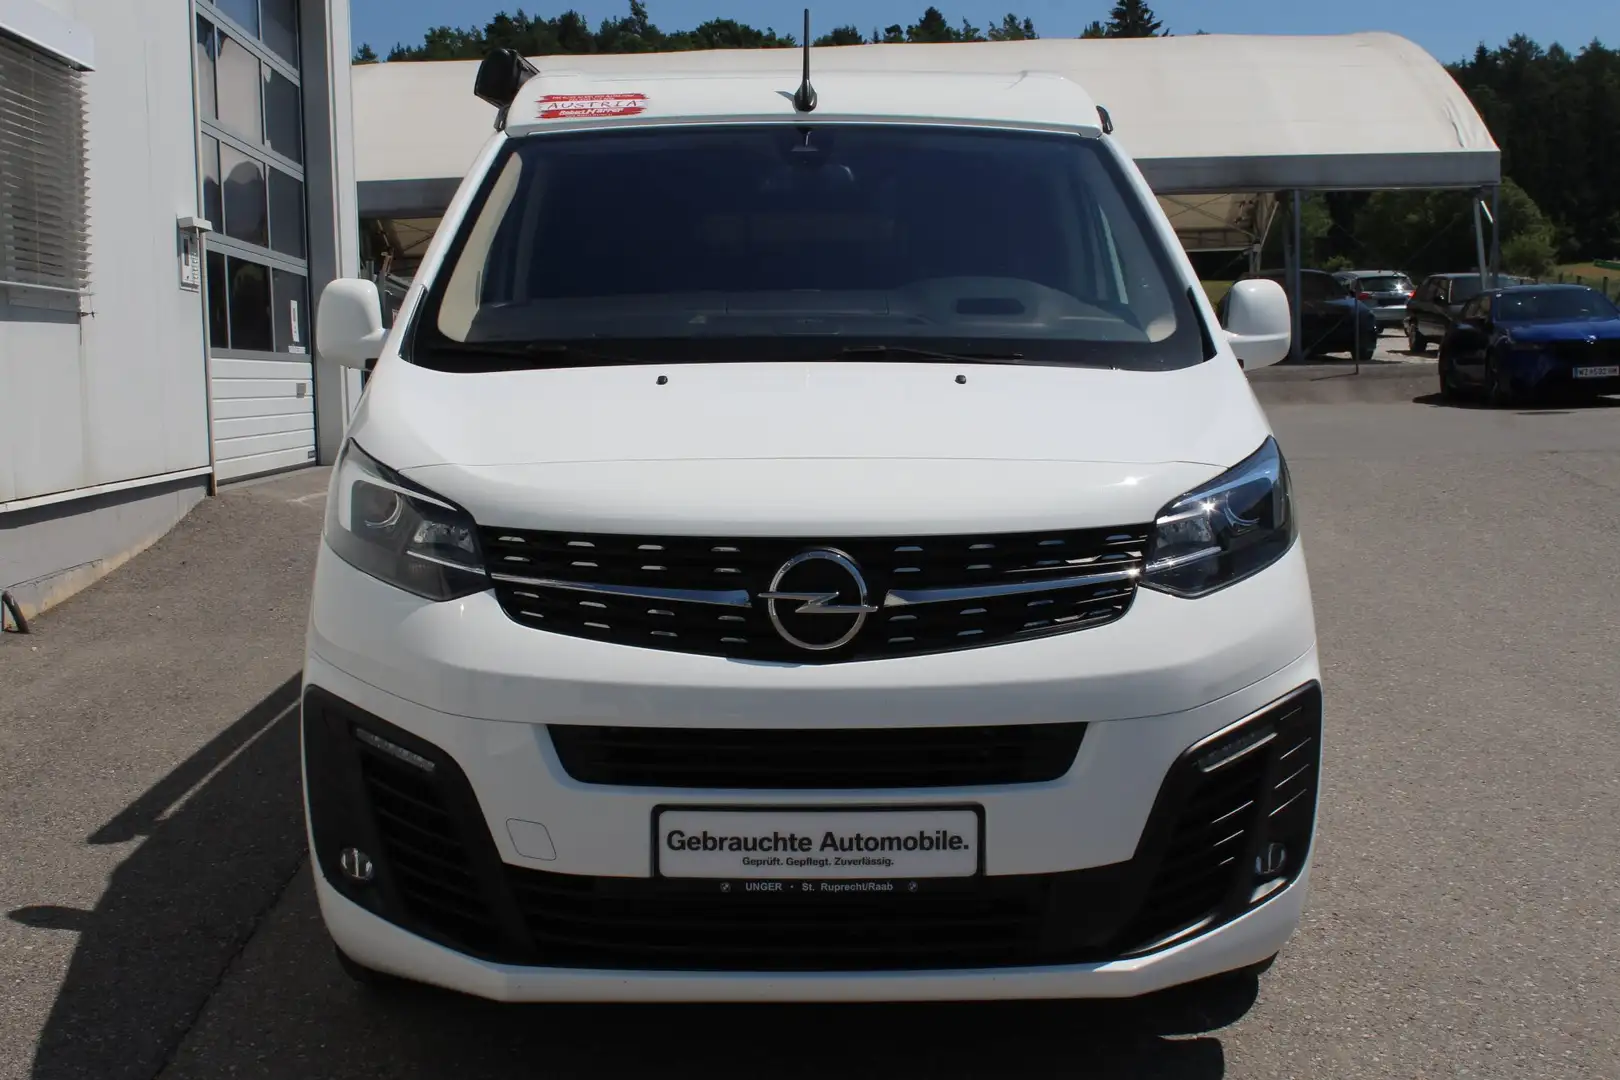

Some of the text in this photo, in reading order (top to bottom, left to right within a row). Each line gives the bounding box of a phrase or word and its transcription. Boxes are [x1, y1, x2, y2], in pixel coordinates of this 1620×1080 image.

[547, 100, 637, 110] AUSTRIA
[666, 829, 969, 852] Gebrauchte Automobile.
[742, 856, 894, 867] Geprüft. Gepflegt. Zuverlässig.
[745, 881, 893, 893] UNGER St. Ruprecht/Raab
